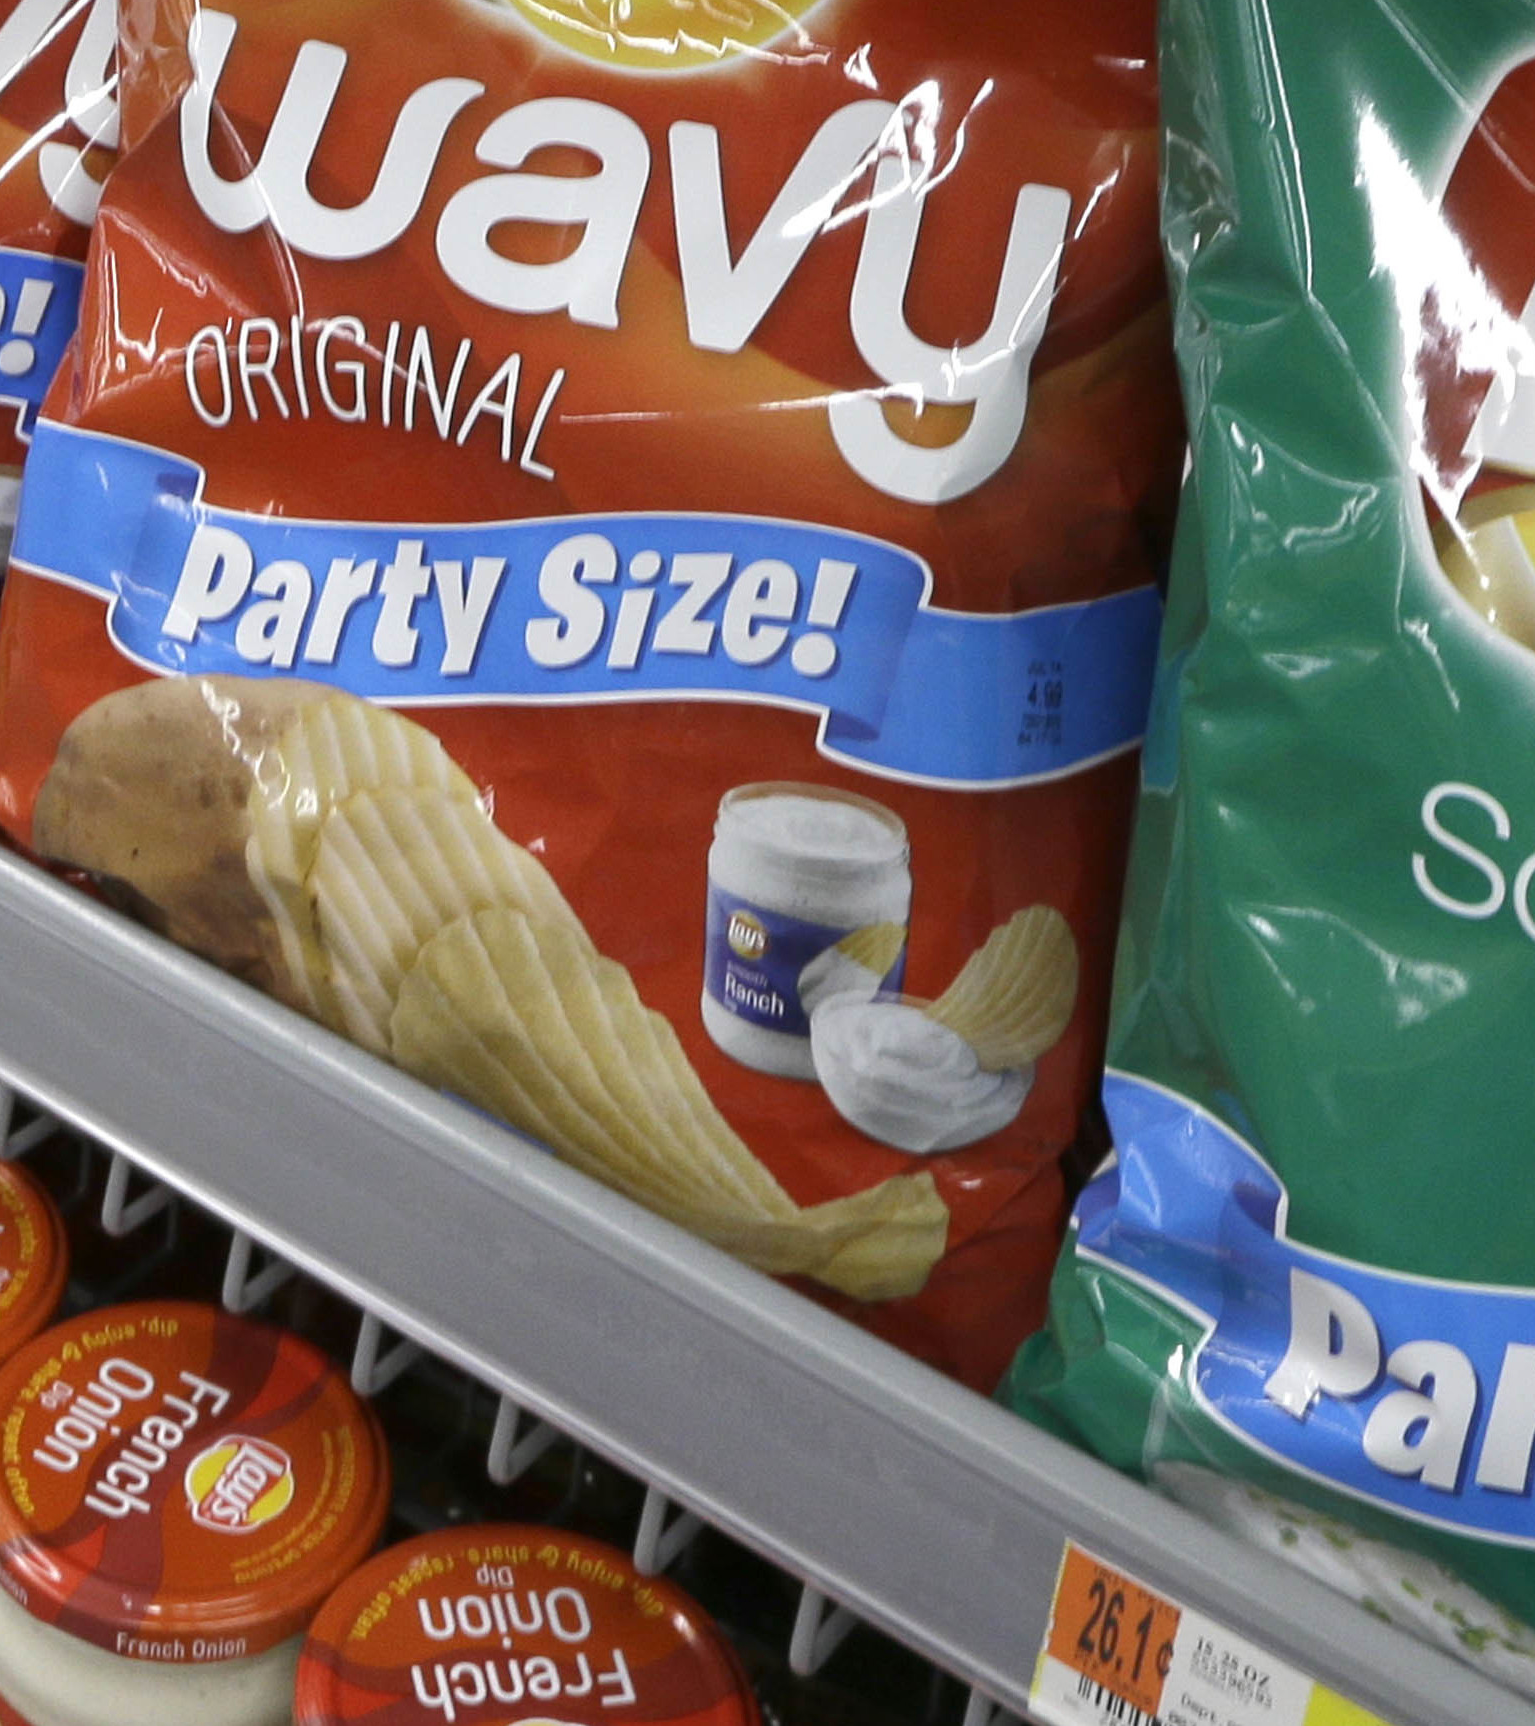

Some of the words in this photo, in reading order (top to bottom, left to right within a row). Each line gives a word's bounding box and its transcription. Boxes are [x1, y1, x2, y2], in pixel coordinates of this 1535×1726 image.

[180, 4, 1072, 506] wavy
[184, 314, 566, 481] ORIGINAL
[159, 526, 506, 677] Party
[525, 533, 859, 678] Size!
[725, 971, 786, 1019] Ranch
[33, 1358, 156, 1472] Onion
[84, 1370, 231, 1519] French
[418, 1586, 592, 1650] Onion
[476, 1563, 515, 1589] Dip
[115, 1631, 185, 1659] French
[192, 1637, 247, 1659] Onion
[411, 1648, 637, 1723] French
